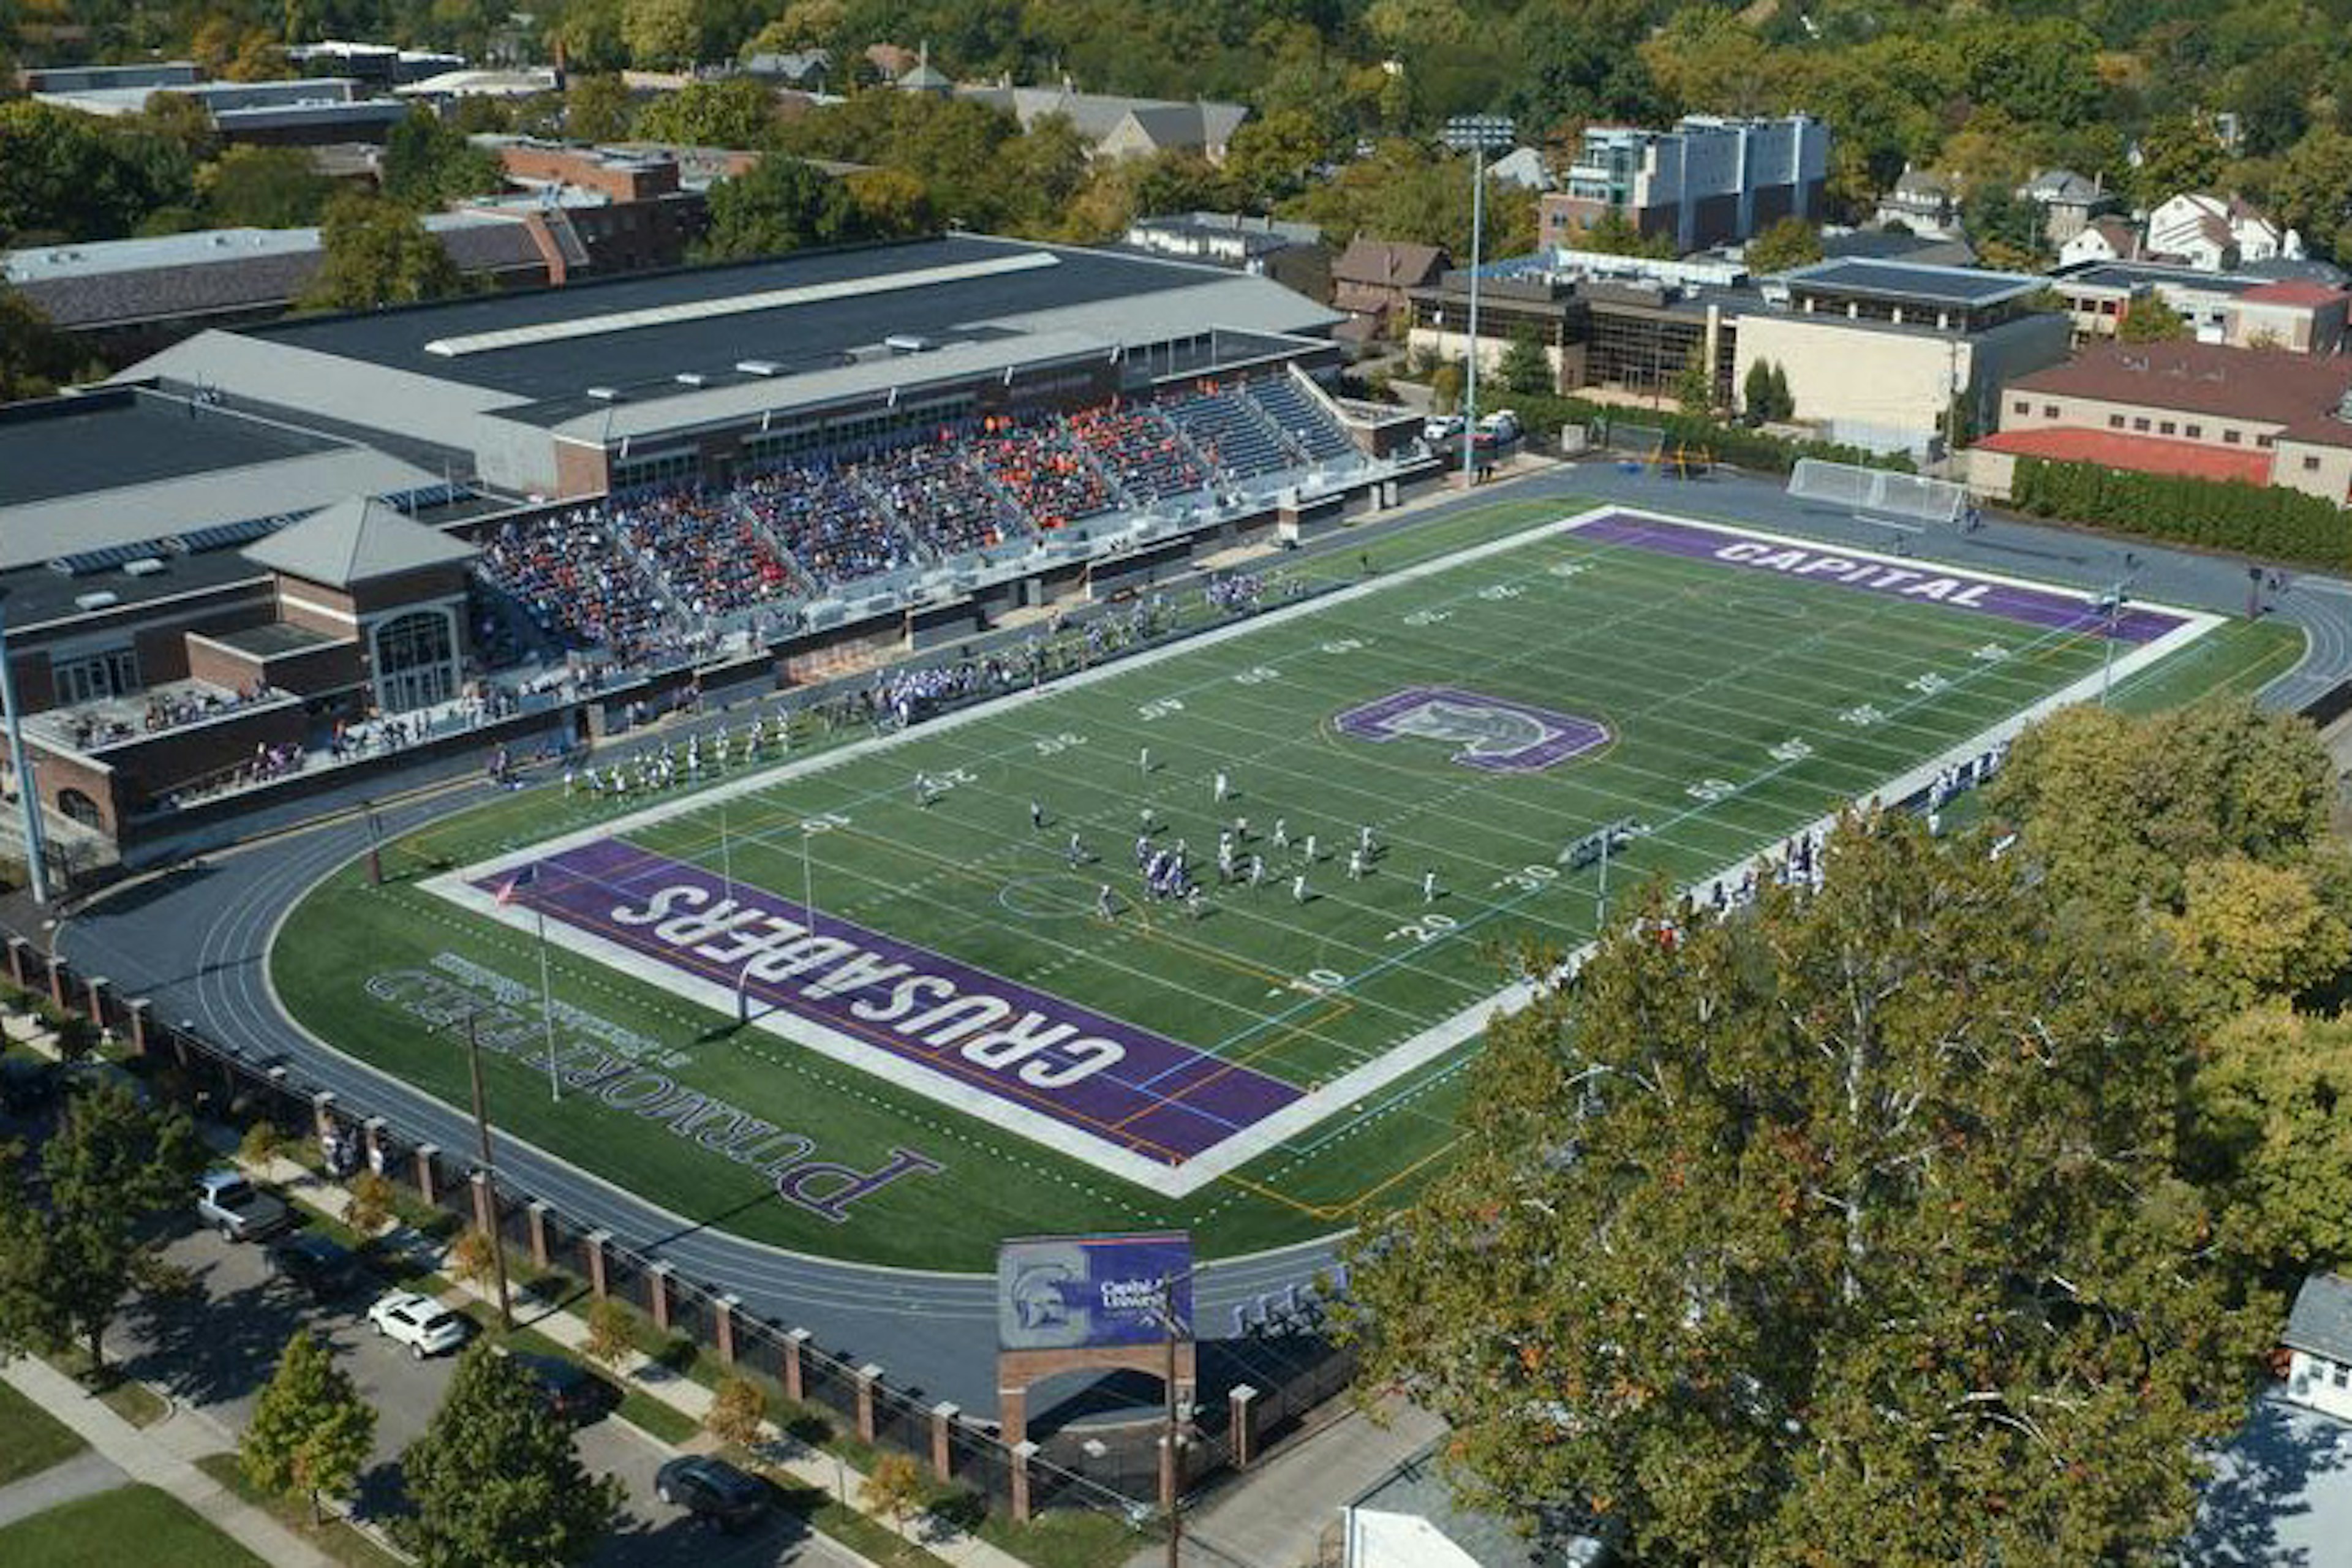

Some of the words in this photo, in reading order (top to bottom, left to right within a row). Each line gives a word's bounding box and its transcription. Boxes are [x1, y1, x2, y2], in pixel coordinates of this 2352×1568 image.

[1715, 543, 1990, 608] CAPITAL
[1400, 914, 1457, 943] 20
[612, 884, 1126, 1090] CRUSADERS
